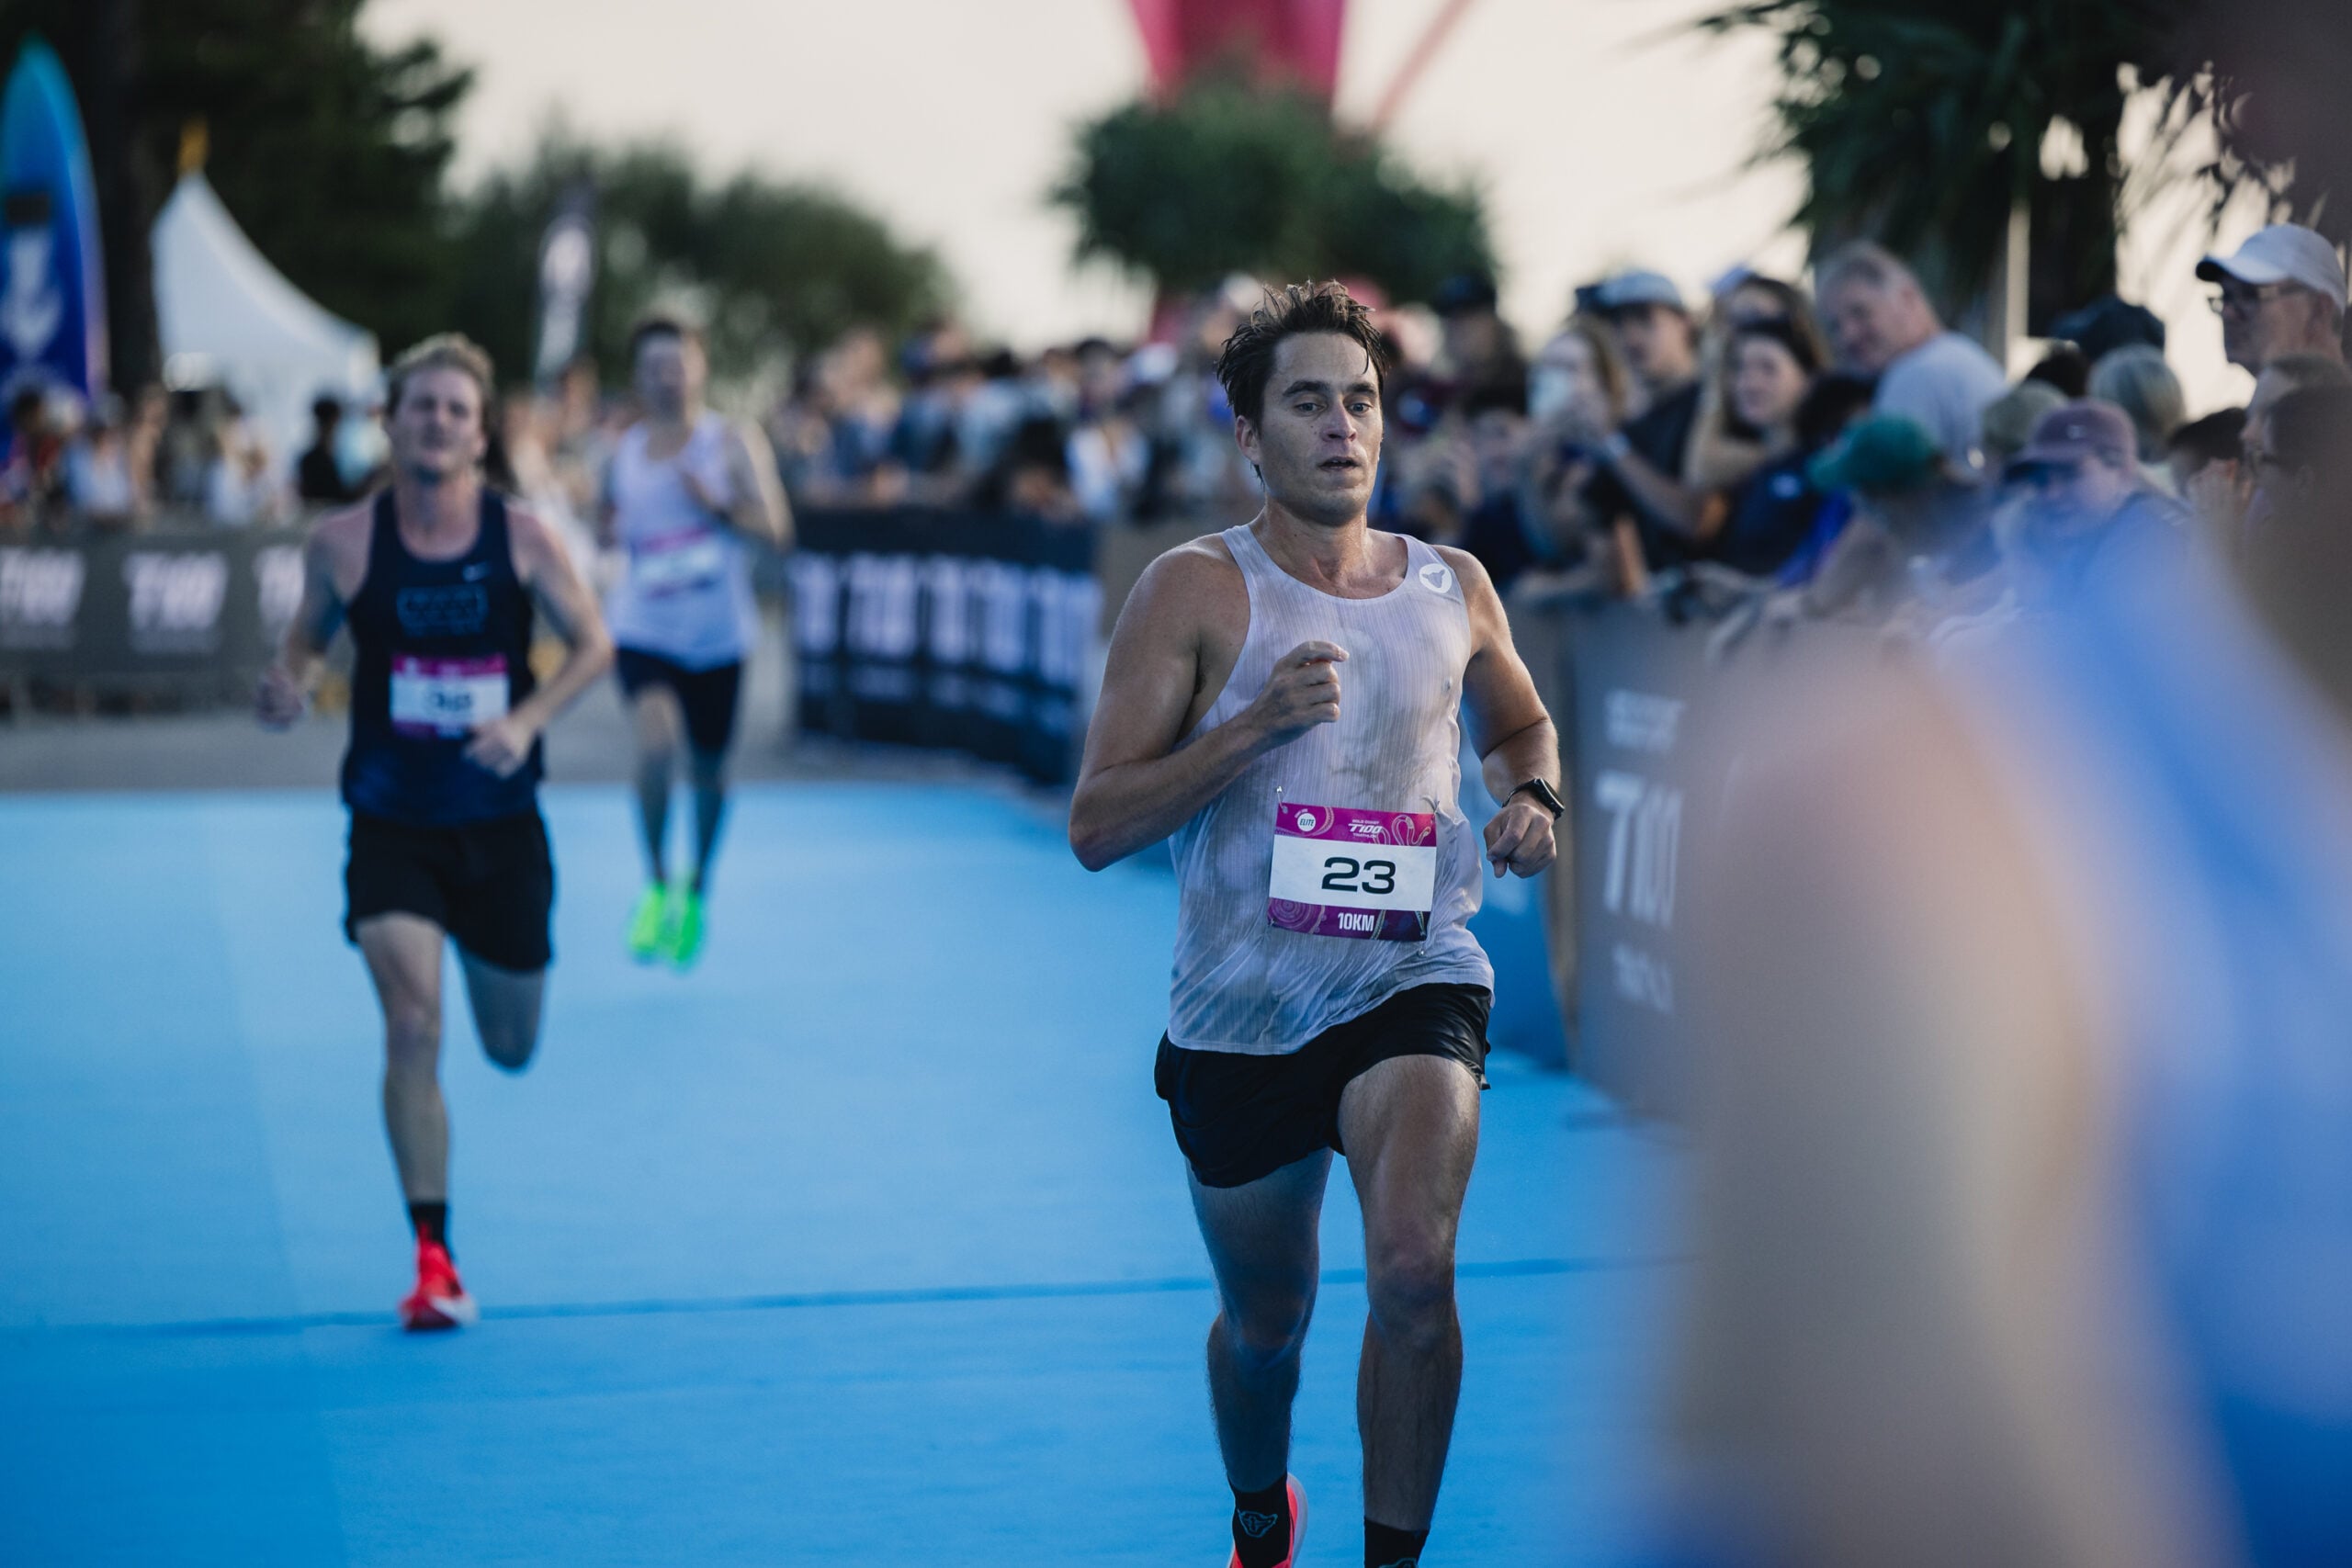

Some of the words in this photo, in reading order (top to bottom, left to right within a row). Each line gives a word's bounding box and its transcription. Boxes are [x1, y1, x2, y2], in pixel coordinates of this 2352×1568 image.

[1299, 818, 1315, 827] ELITE
[1348, 823, 1383, 834] T100
[1321, 857, 1396, 895] 23
[1338, 912, 1374, 931] 10KM
